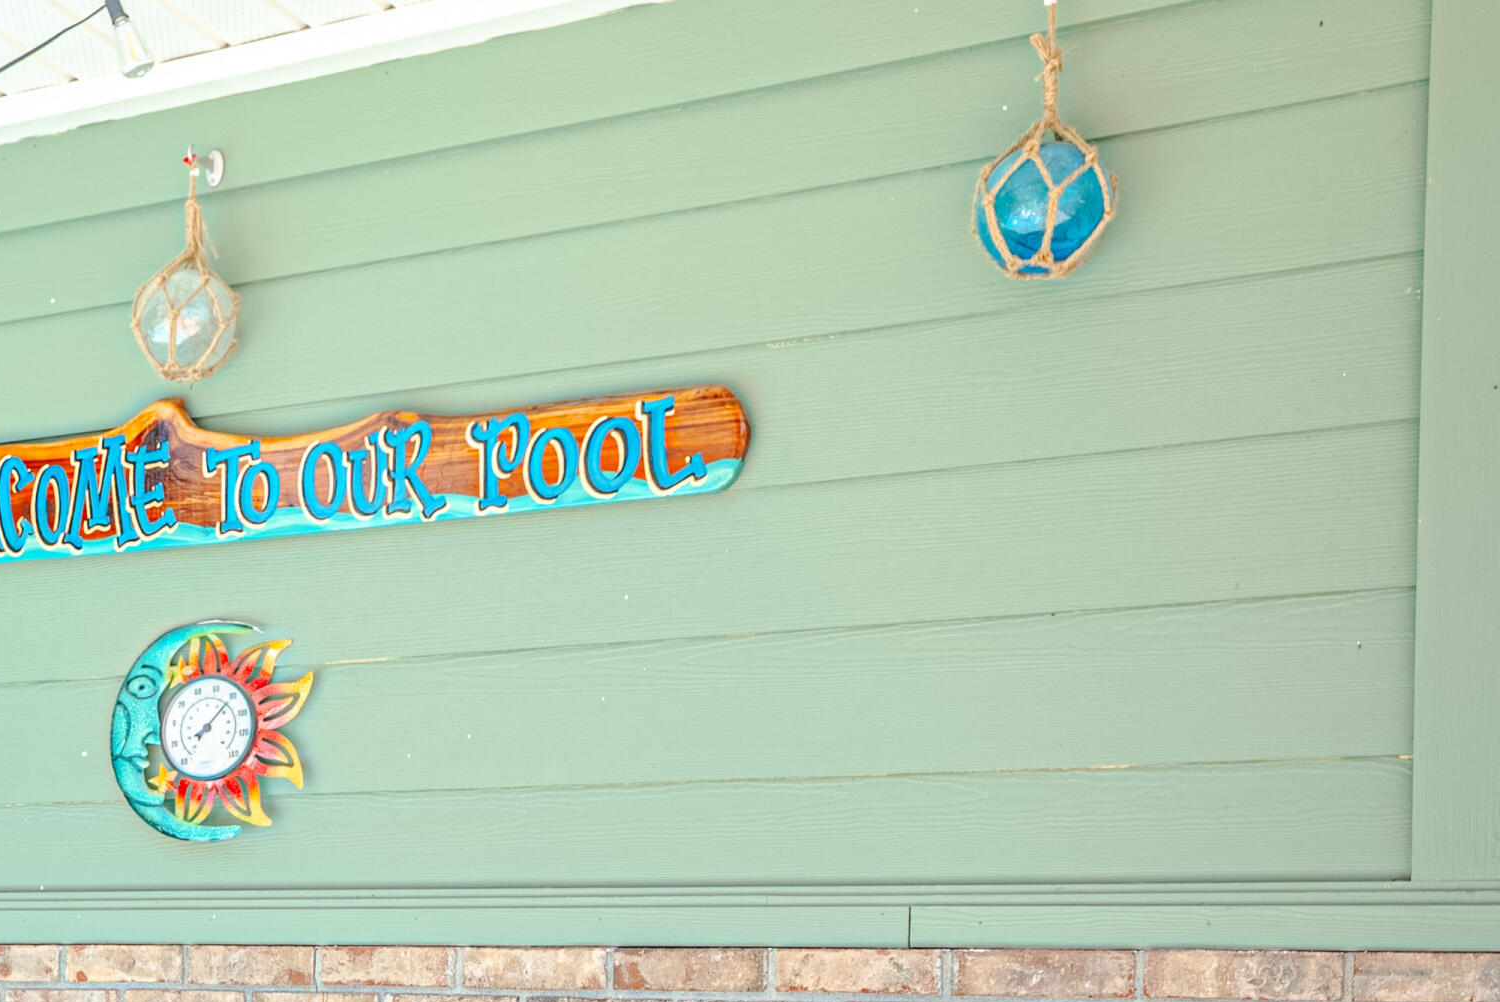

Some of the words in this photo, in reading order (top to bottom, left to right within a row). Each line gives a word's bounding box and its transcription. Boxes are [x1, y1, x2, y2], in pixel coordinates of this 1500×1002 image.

[202, 440, 281, 537] TO
[297, 420, 447, 523] OUR
[465, 396, 708, 515] POOL
